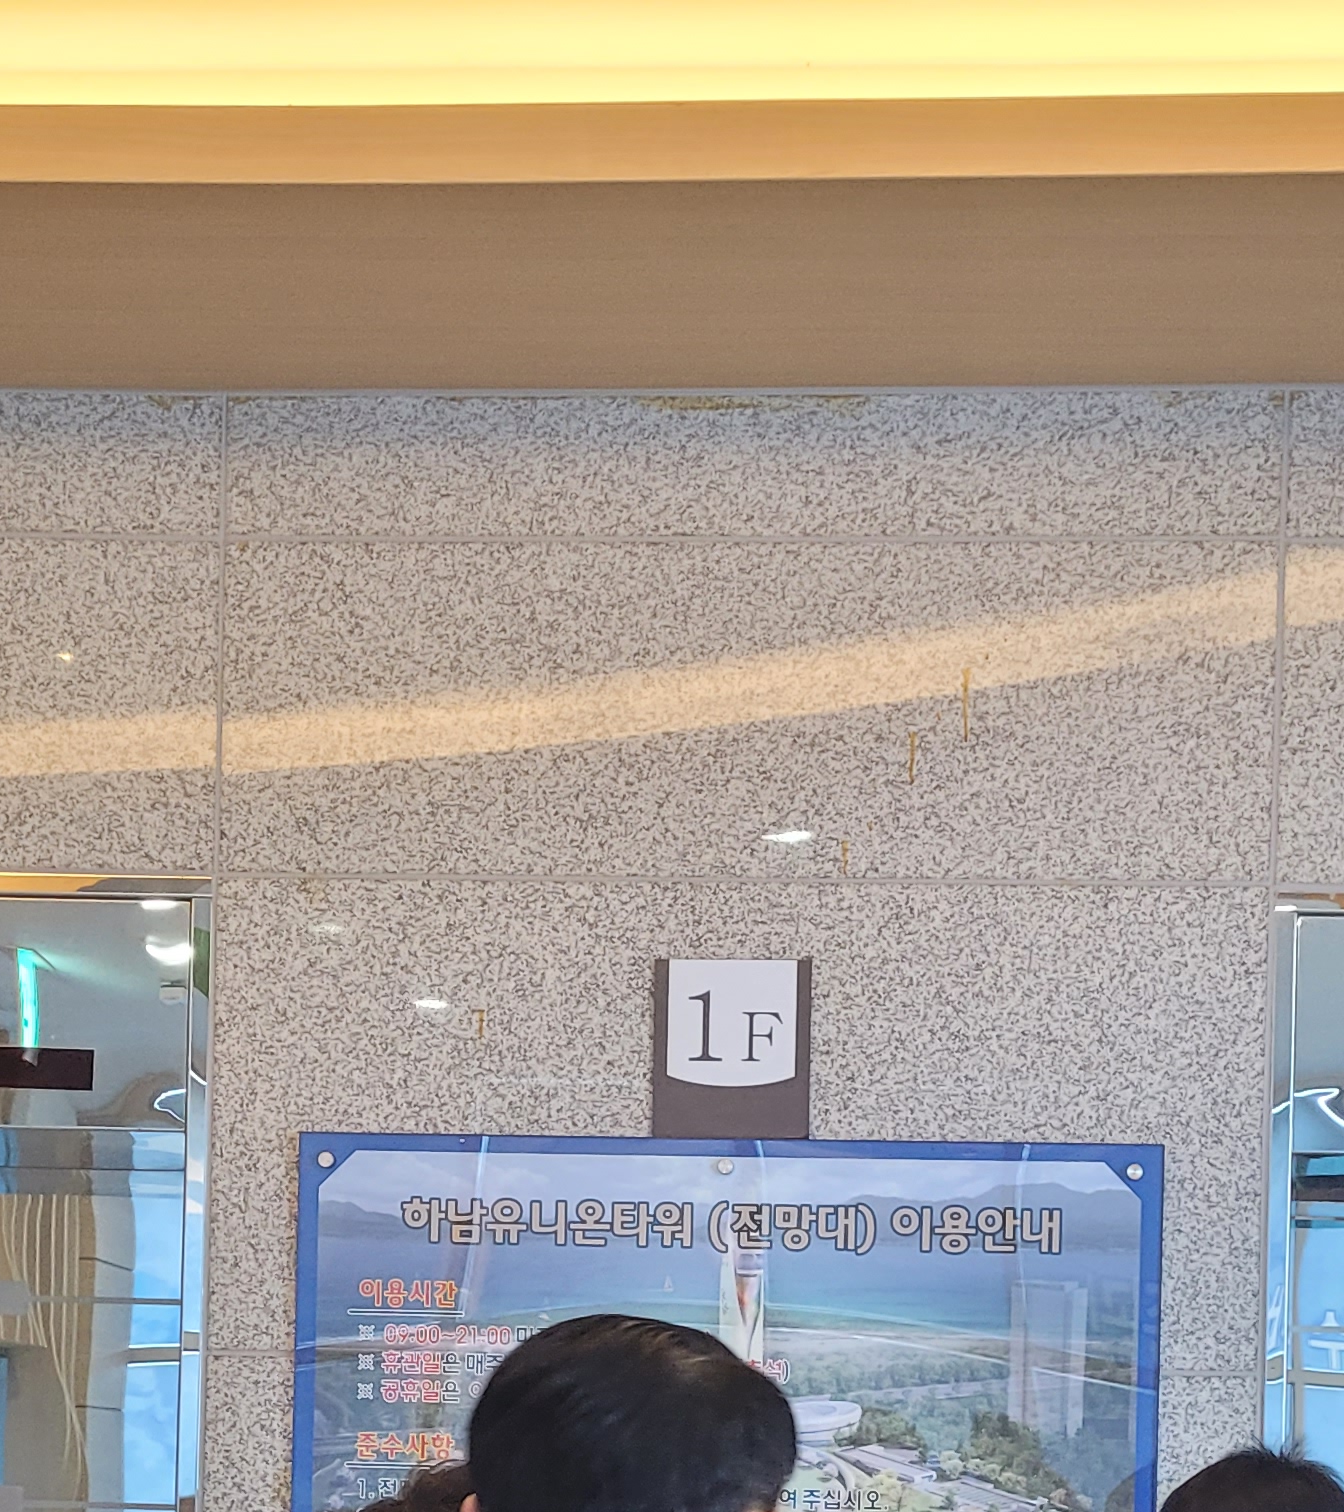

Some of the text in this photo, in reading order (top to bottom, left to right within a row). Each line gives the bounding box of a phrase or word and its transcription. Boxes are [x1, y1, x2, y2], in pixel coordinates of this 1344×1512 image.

[402, 1196, 1062, 1256] 하남유니온타워 (전망대) 이용안내
[359, 1278, 458, 1309] 이용시간
[384, 1324, 512, 1346] 09:00~21:00
[381, 1351, 461, 1375] 휴관일은
[380, 1379, 461, 1403] 공휴일은
[355, 1431, 456, 1460] 준수사항
[802, 1488, 890, 1511] 주십시오.
